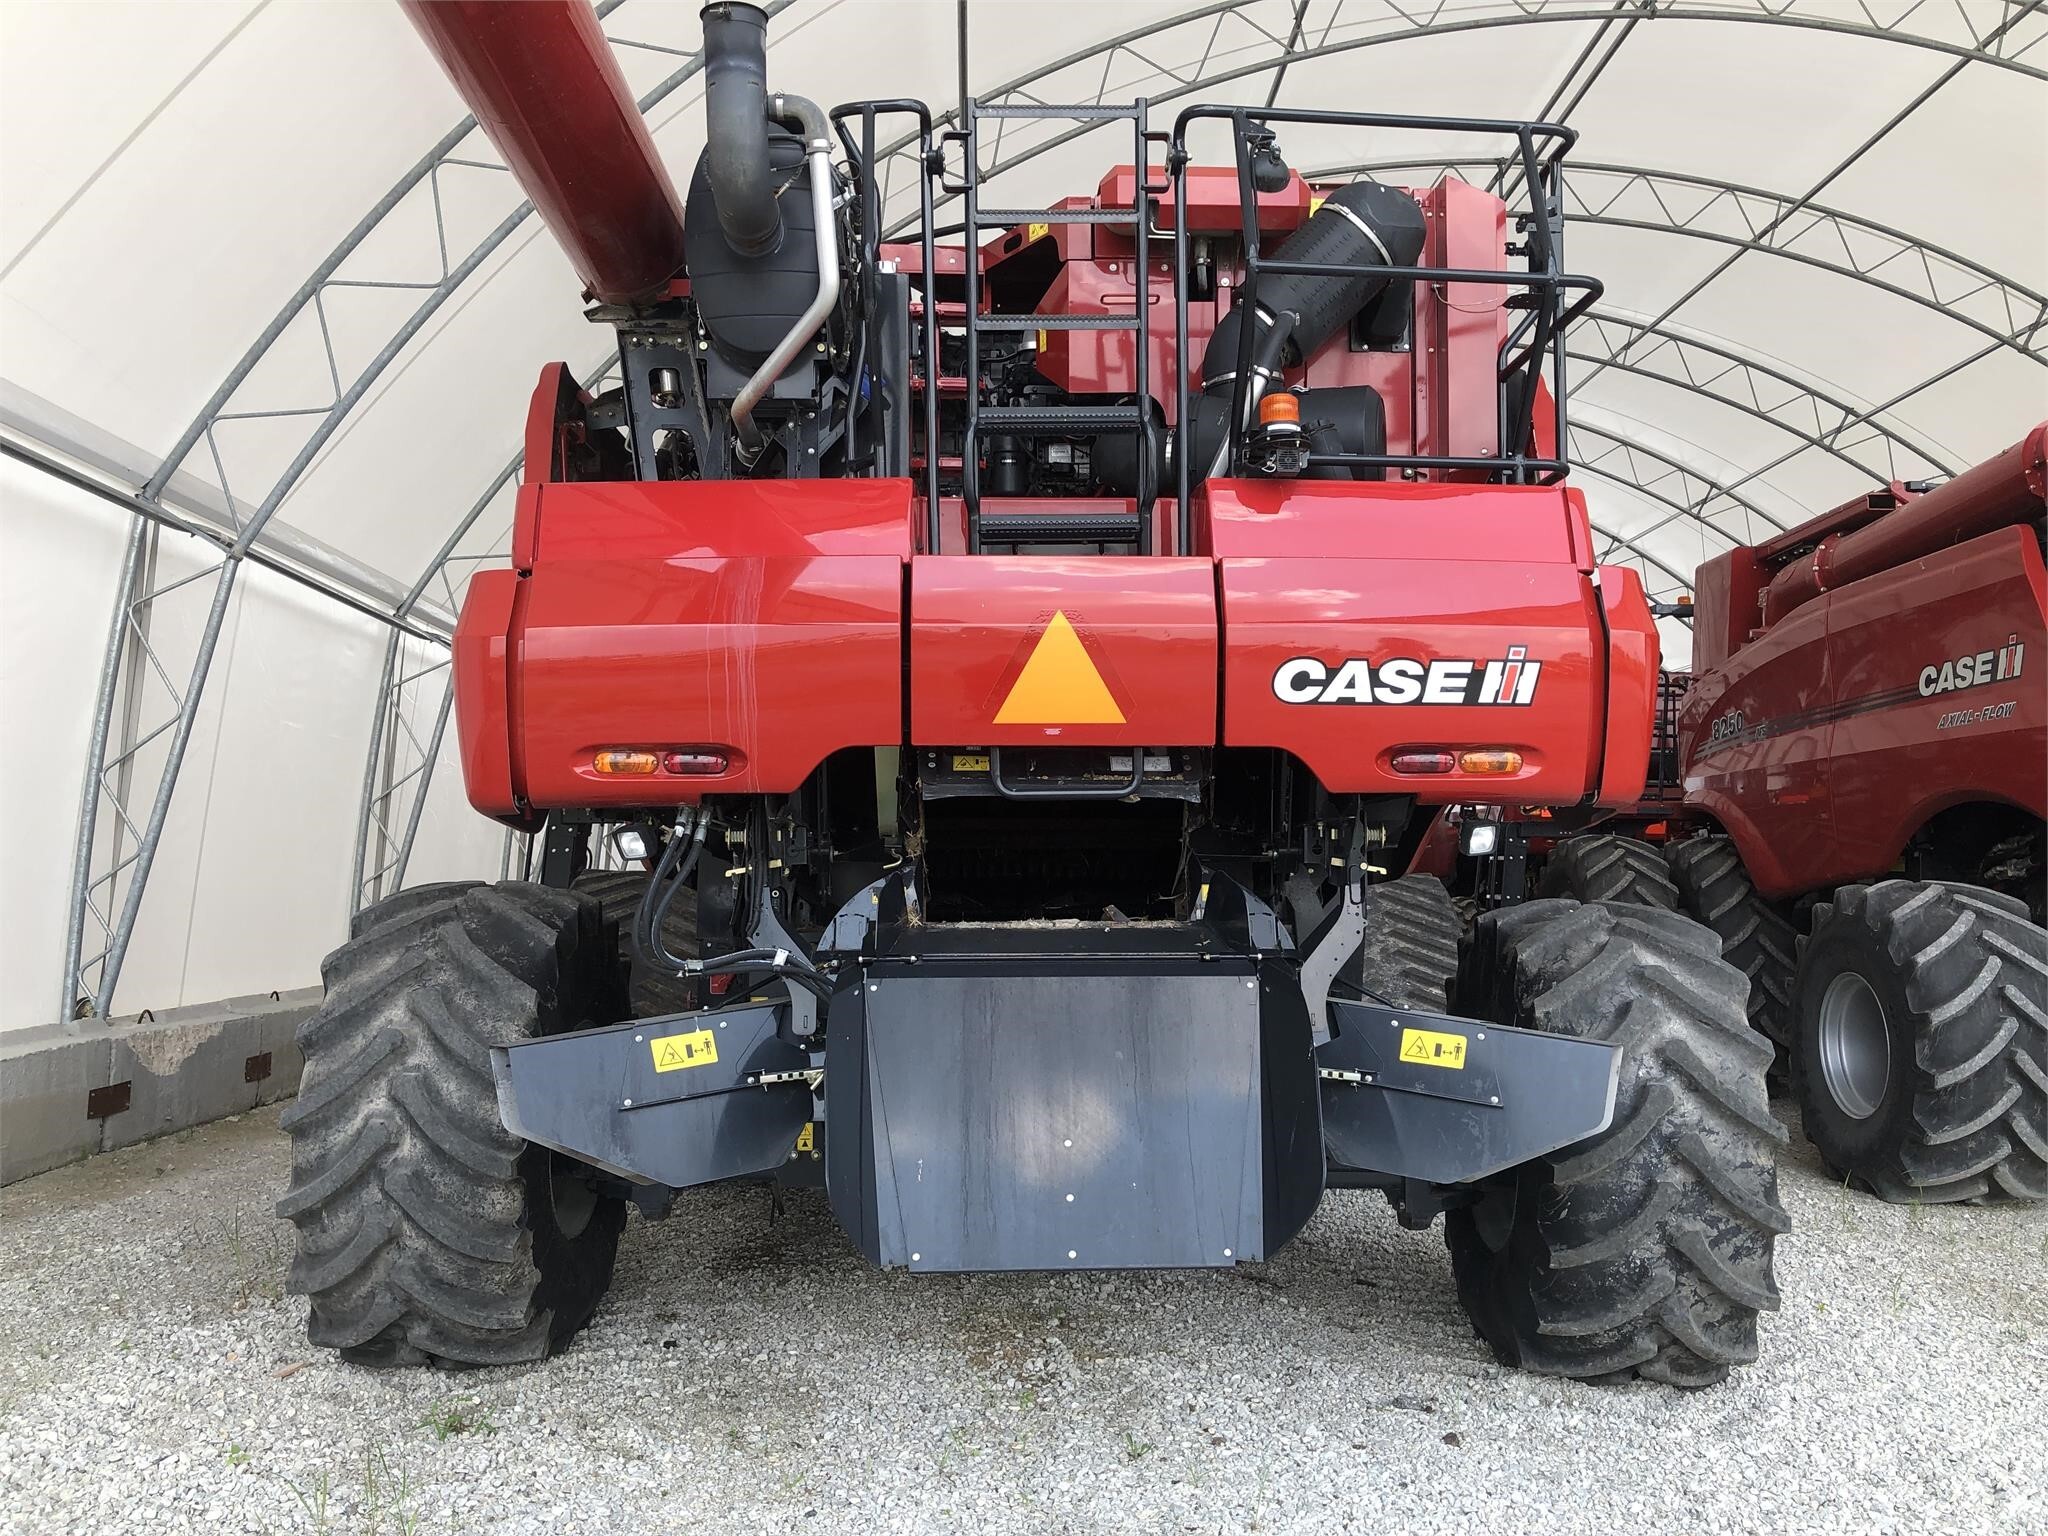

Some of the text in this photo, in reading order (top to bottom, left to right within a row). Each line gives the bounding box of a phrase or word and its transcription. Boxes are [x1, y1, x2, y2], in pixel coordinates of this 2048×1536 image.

[1272, 658, 1473, 705] CASE
[1919, 651, 1994, 697] CASE
[1711, 710, 1744, 742] 8250
[1936, 701, 2017, 730] AXIAL-FLOW
